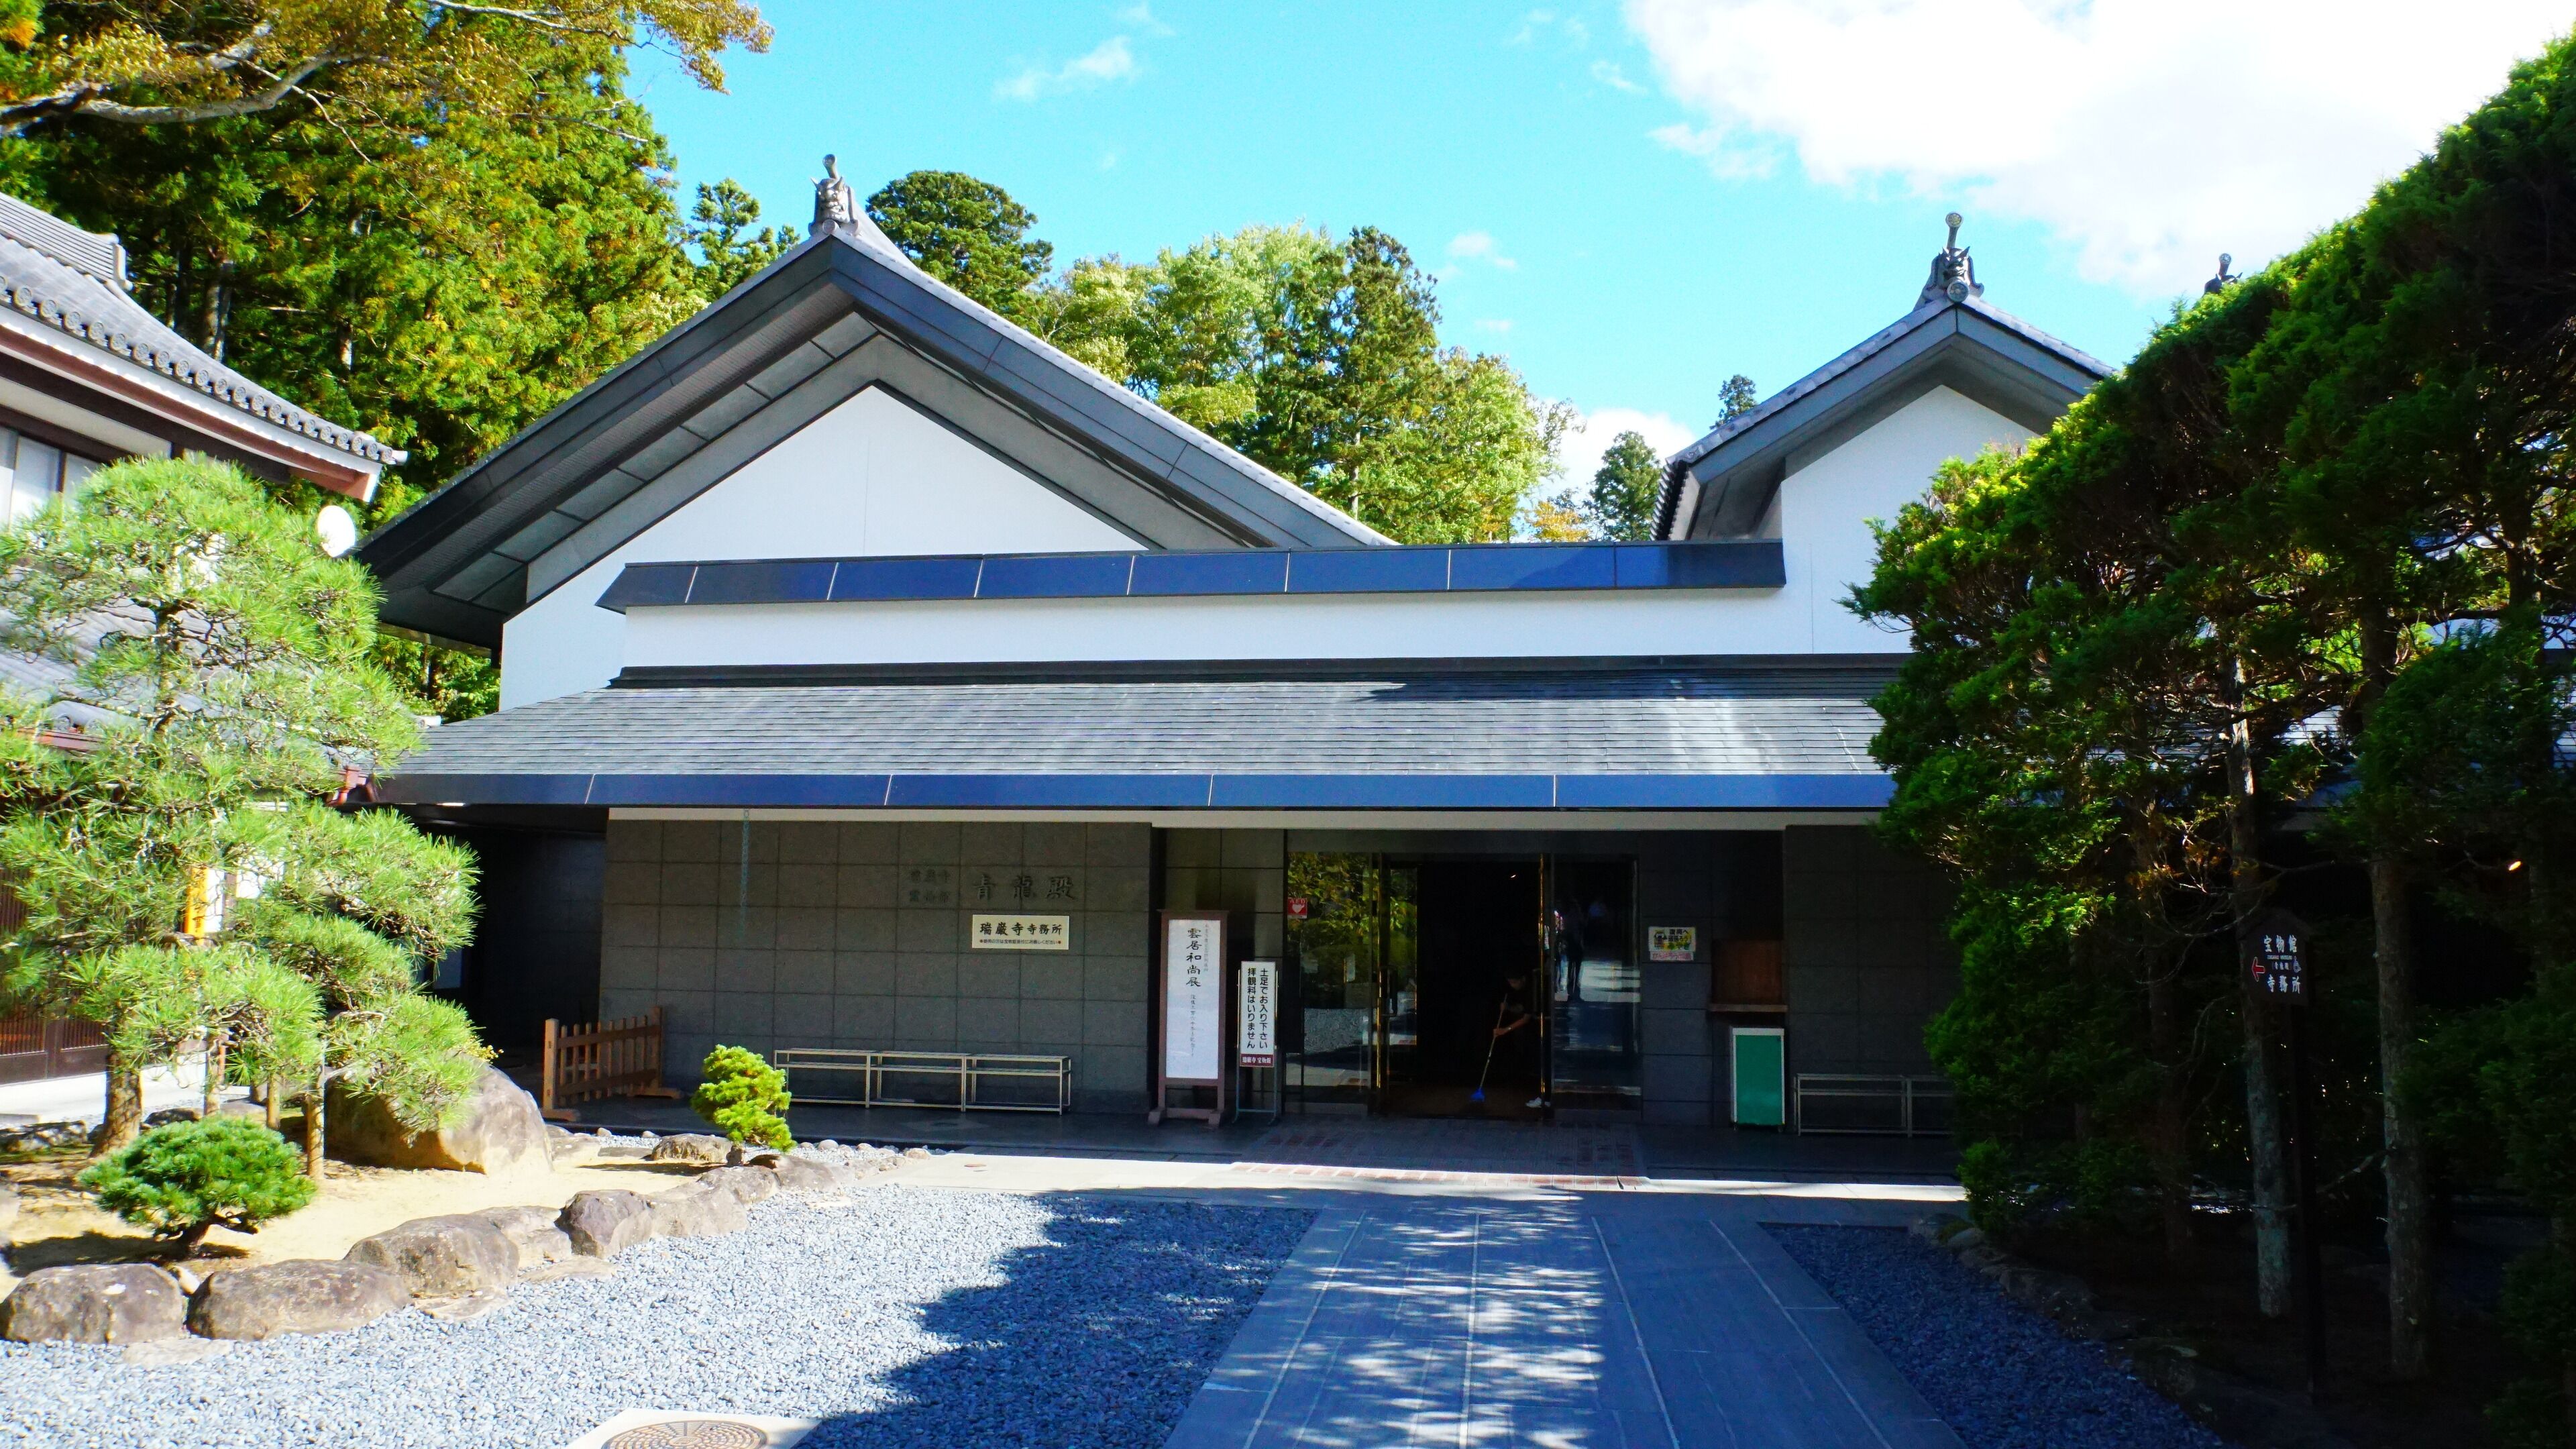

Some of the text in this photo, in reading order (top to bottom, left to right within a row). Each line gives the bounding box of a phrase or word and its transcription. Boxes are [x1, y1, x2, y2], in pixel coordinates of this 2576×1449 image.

[972, 873, 1075, 902] 青龍殿
[1185, 928, 1202, 987] 雲居和尚展
[2263, 934, 2298, 953] 宝物館
[2267, 973, 2301, 994] 寺務所
[1246, 967, 1256, 1049] 拝観料はいりません
[1259, 968, 1269, 1049] 土足でお入り下さい
